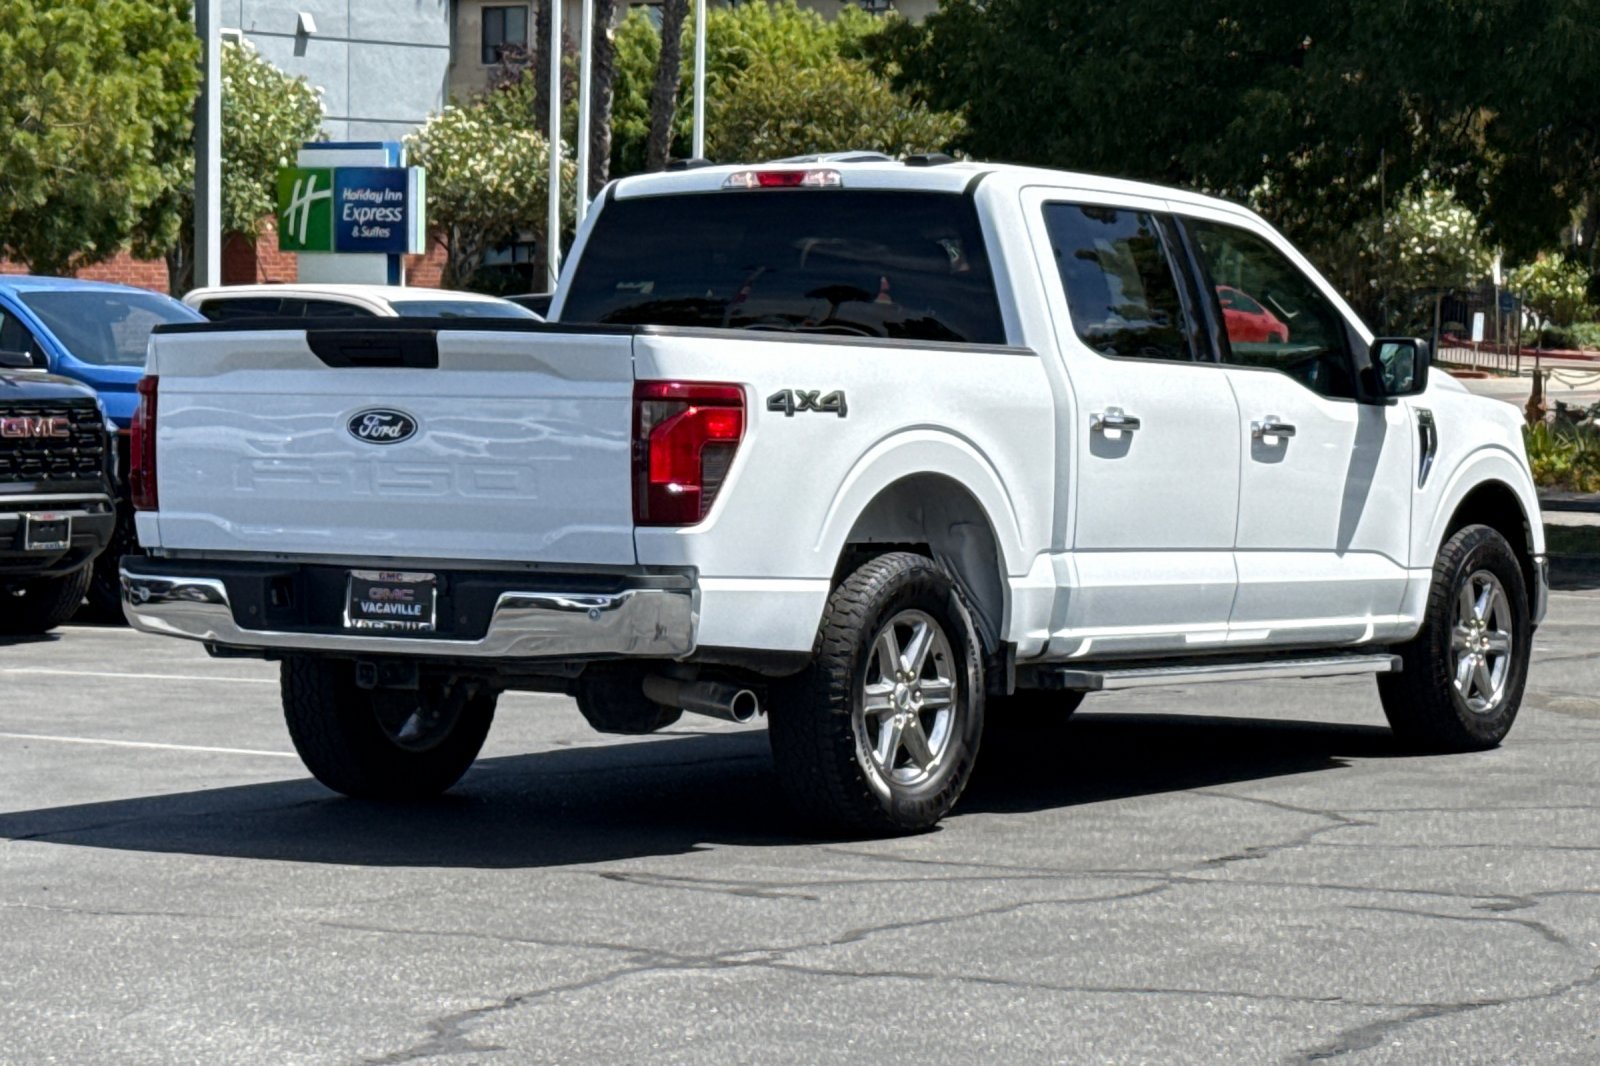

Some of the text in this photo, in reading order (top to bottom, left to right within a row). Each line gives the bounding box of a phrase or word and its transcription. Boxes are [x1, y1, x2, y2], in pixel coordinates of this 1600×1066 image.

[342, 187, 403, 203] Holiday Inn
[342, 203, 403, 225] Express
[351, 226, 391, 238] & Suites
[0, 416, 70, 437] GMC
[359, 413, 404, 438] Ford
[233, 456, 538, 500] F-150
[368, 587, 415, 601] GMC
[360, 601, 423, 616] VACAVILLE
